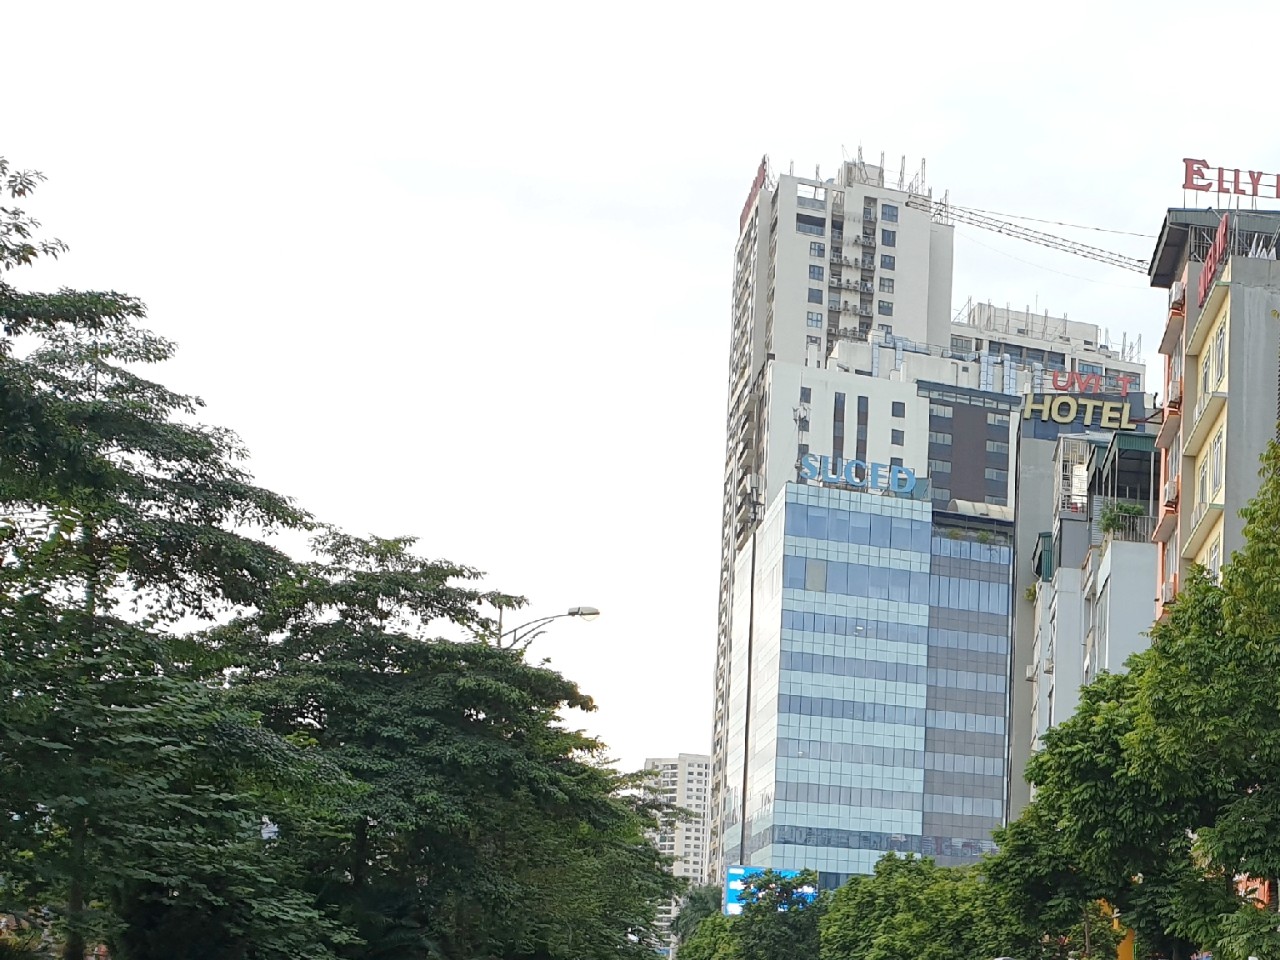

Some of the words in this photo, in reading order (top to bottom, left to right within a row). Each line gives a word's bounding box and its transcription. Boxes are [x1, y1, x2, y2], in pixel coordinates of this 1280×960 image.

[1182, 158, 1263, 197] ELLY
[1023, 393, 1137, 430] HOTEL
[800, 453, 917, 493] SUCED
